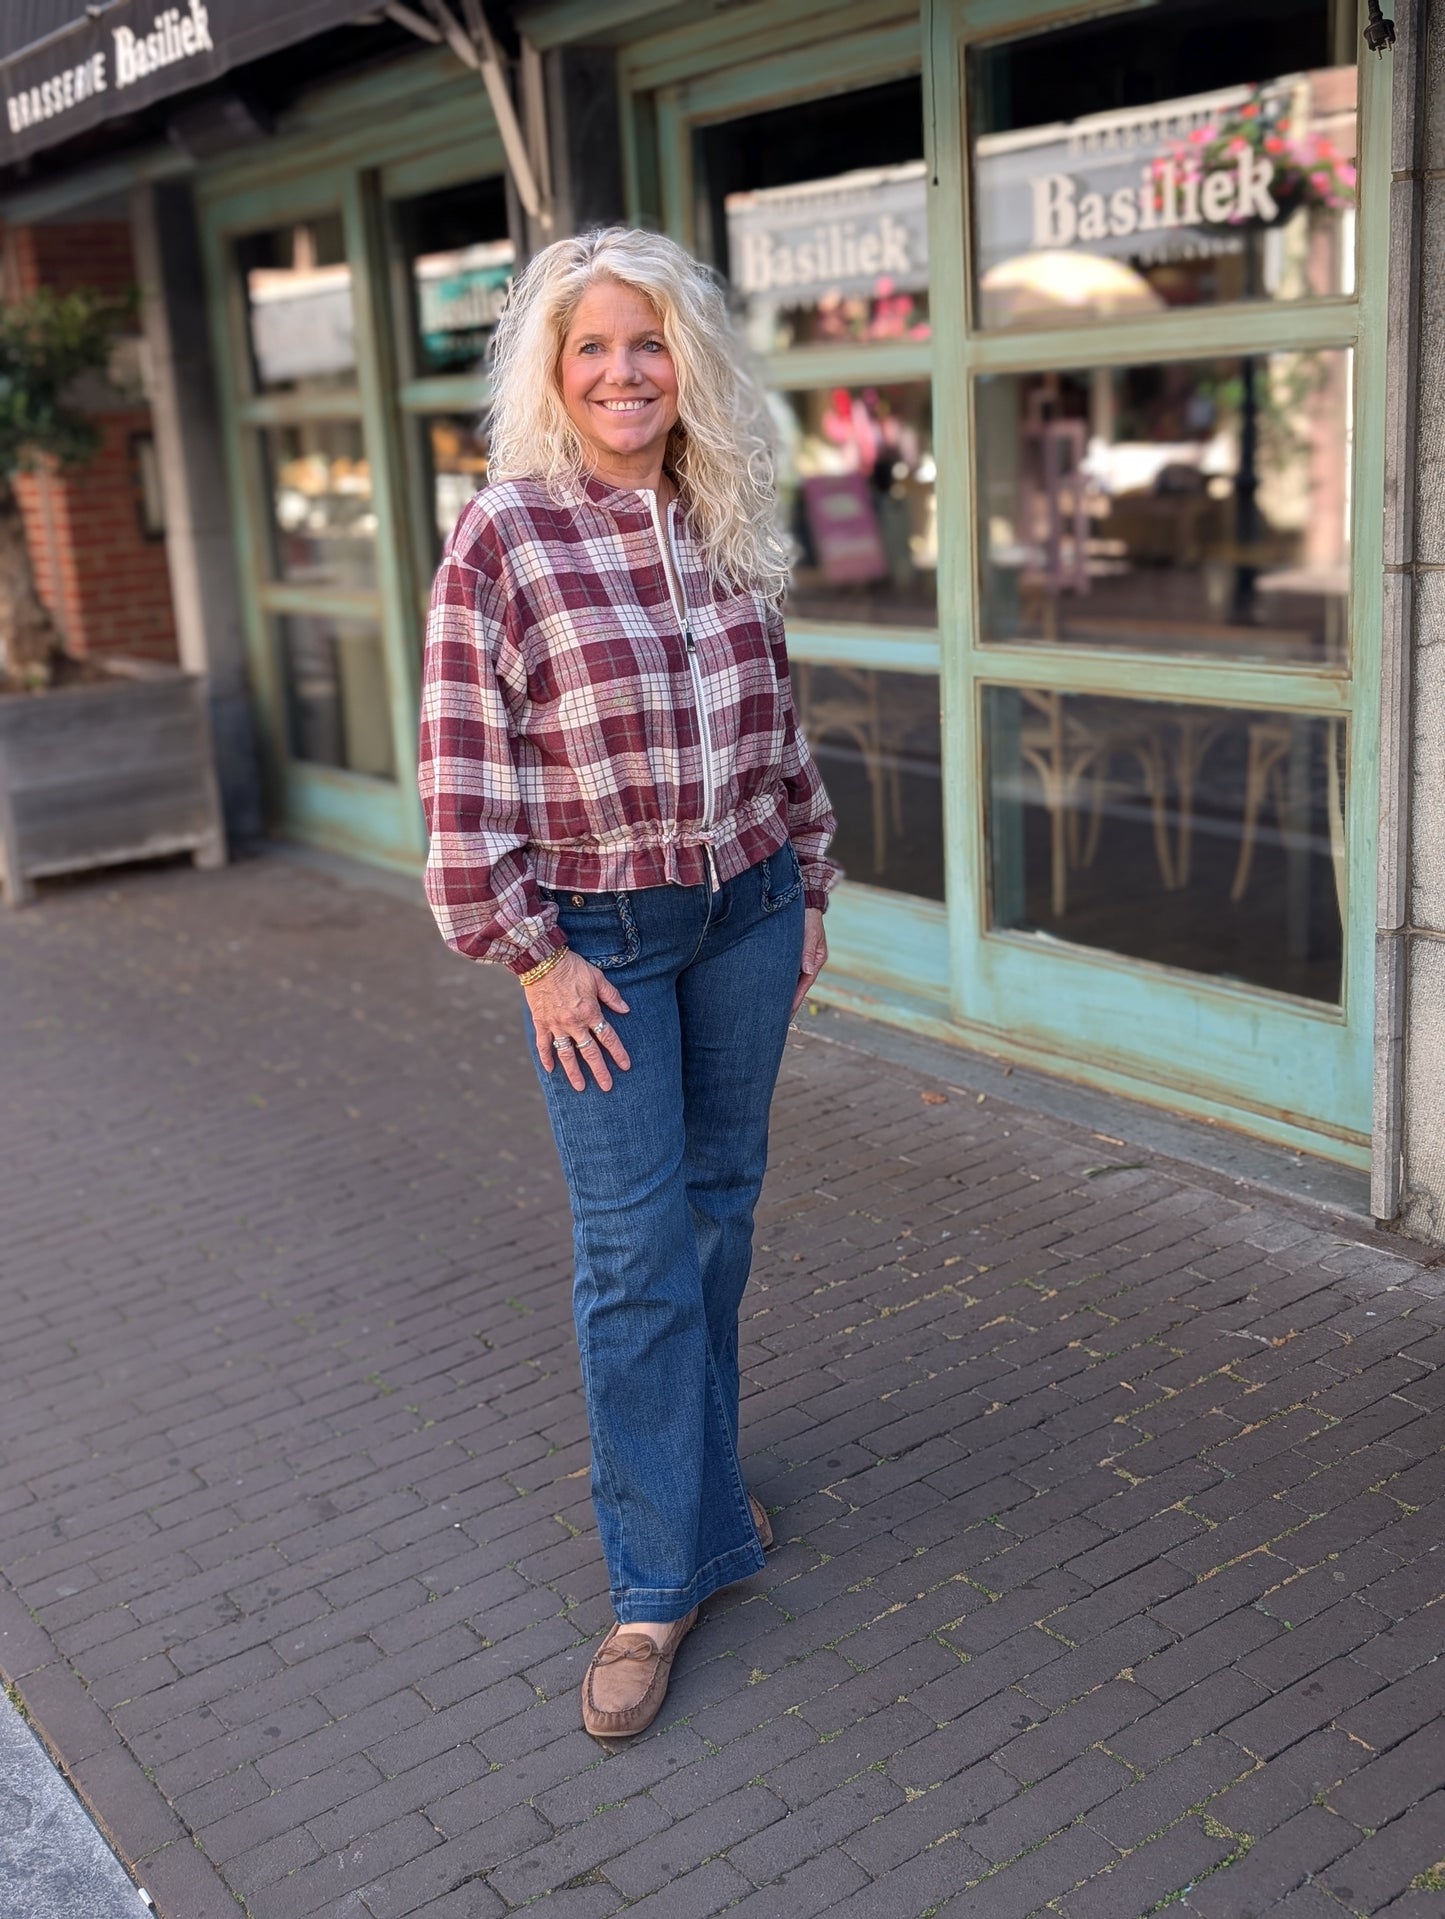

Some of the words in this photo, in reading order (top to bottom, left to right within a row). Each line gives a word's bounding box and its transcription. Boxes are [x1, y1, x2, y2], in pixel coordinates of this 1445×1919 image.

[111, 0, 214, 90] Basiliek
[1031, 145, 1279, 248] Basiliek
[741, 213, 910, 293] Basiliek
